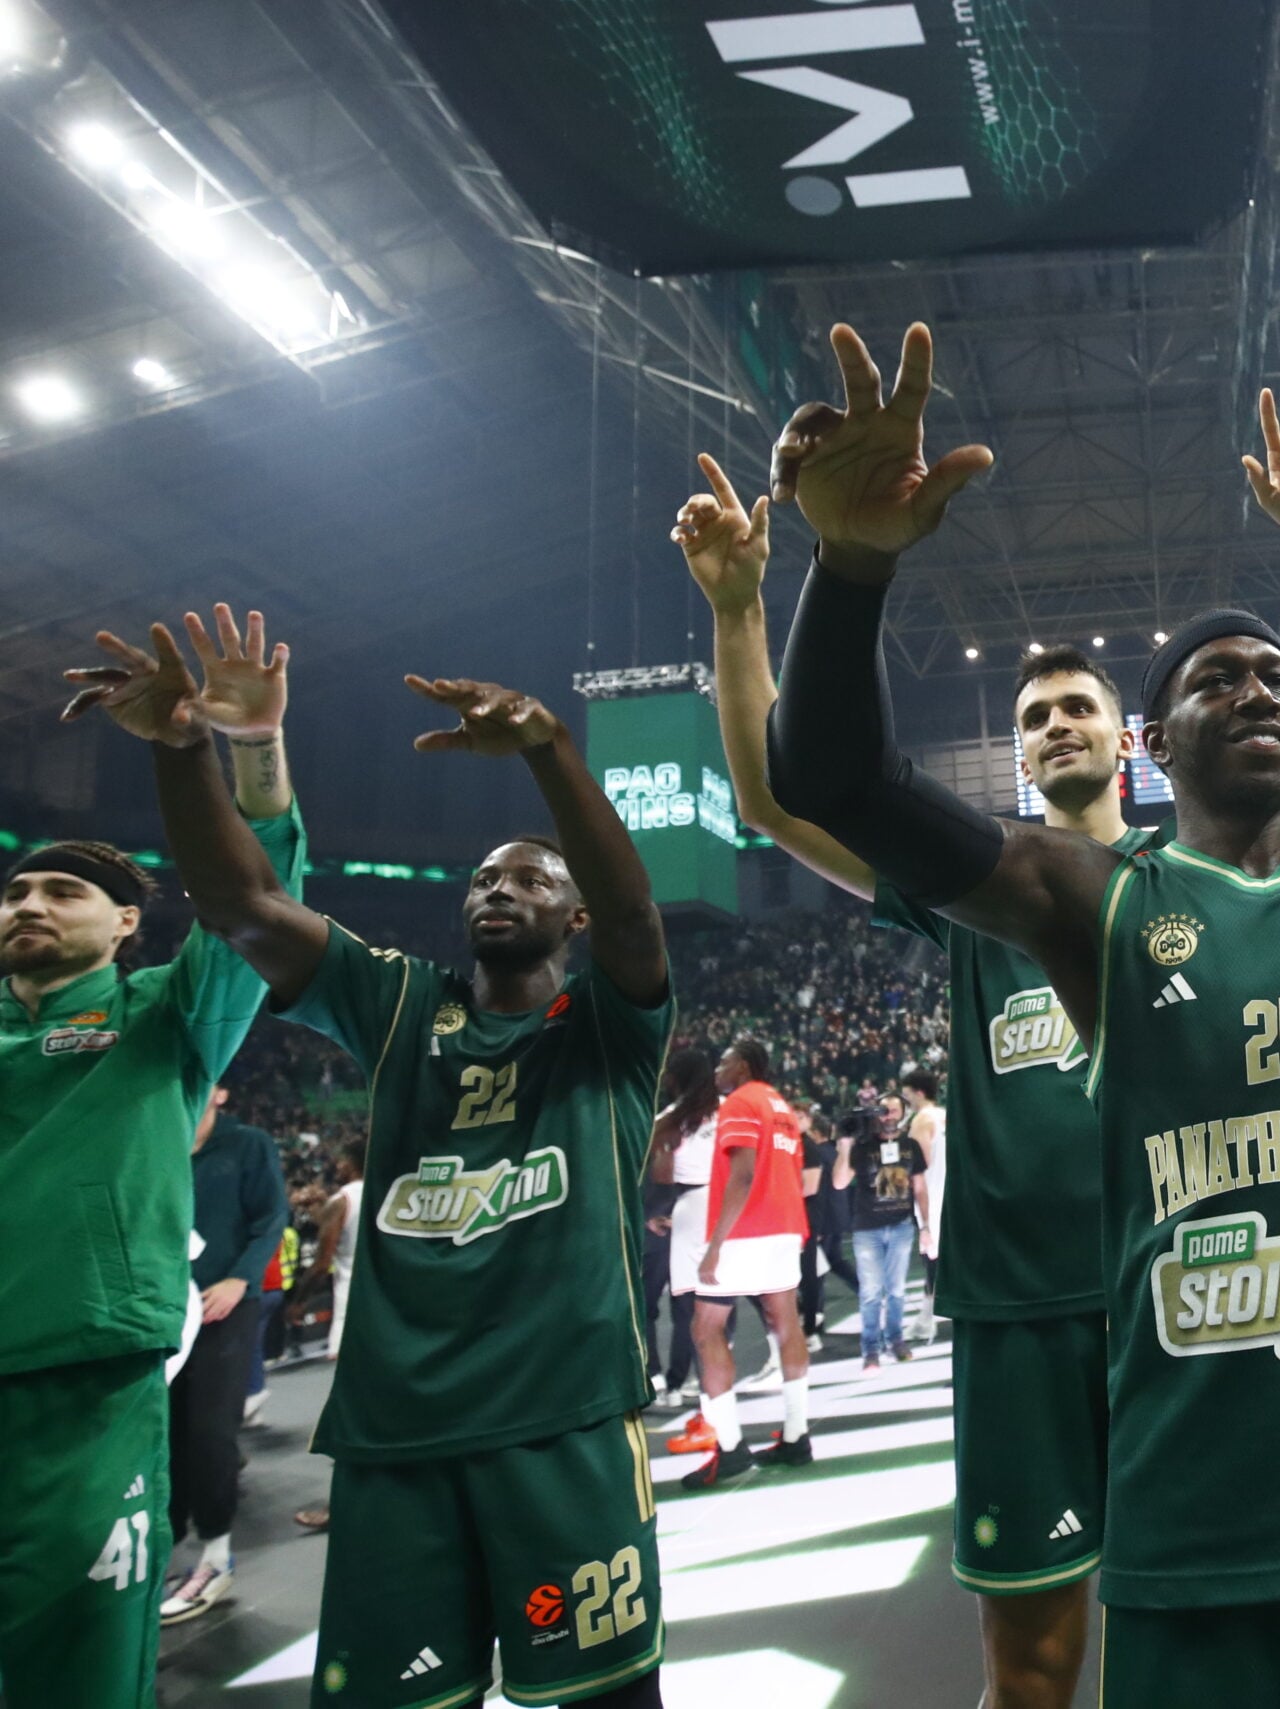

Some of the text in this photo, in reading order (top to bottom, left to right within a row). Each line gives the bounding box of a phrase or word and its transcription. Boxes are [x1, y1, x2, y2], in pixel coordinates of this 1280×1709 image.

[604, 762, 682, 801] PAO
[1009, 996, 1048, 1021] pame
[1000, 1014, 1070, 1059] stoi
[450, 1060, 518, 1130] 22
[1187, 1228, 1249, 1264] pame
[87, 1509, 150, 1591] 41
[571, 1544, 648, 1651] 22
